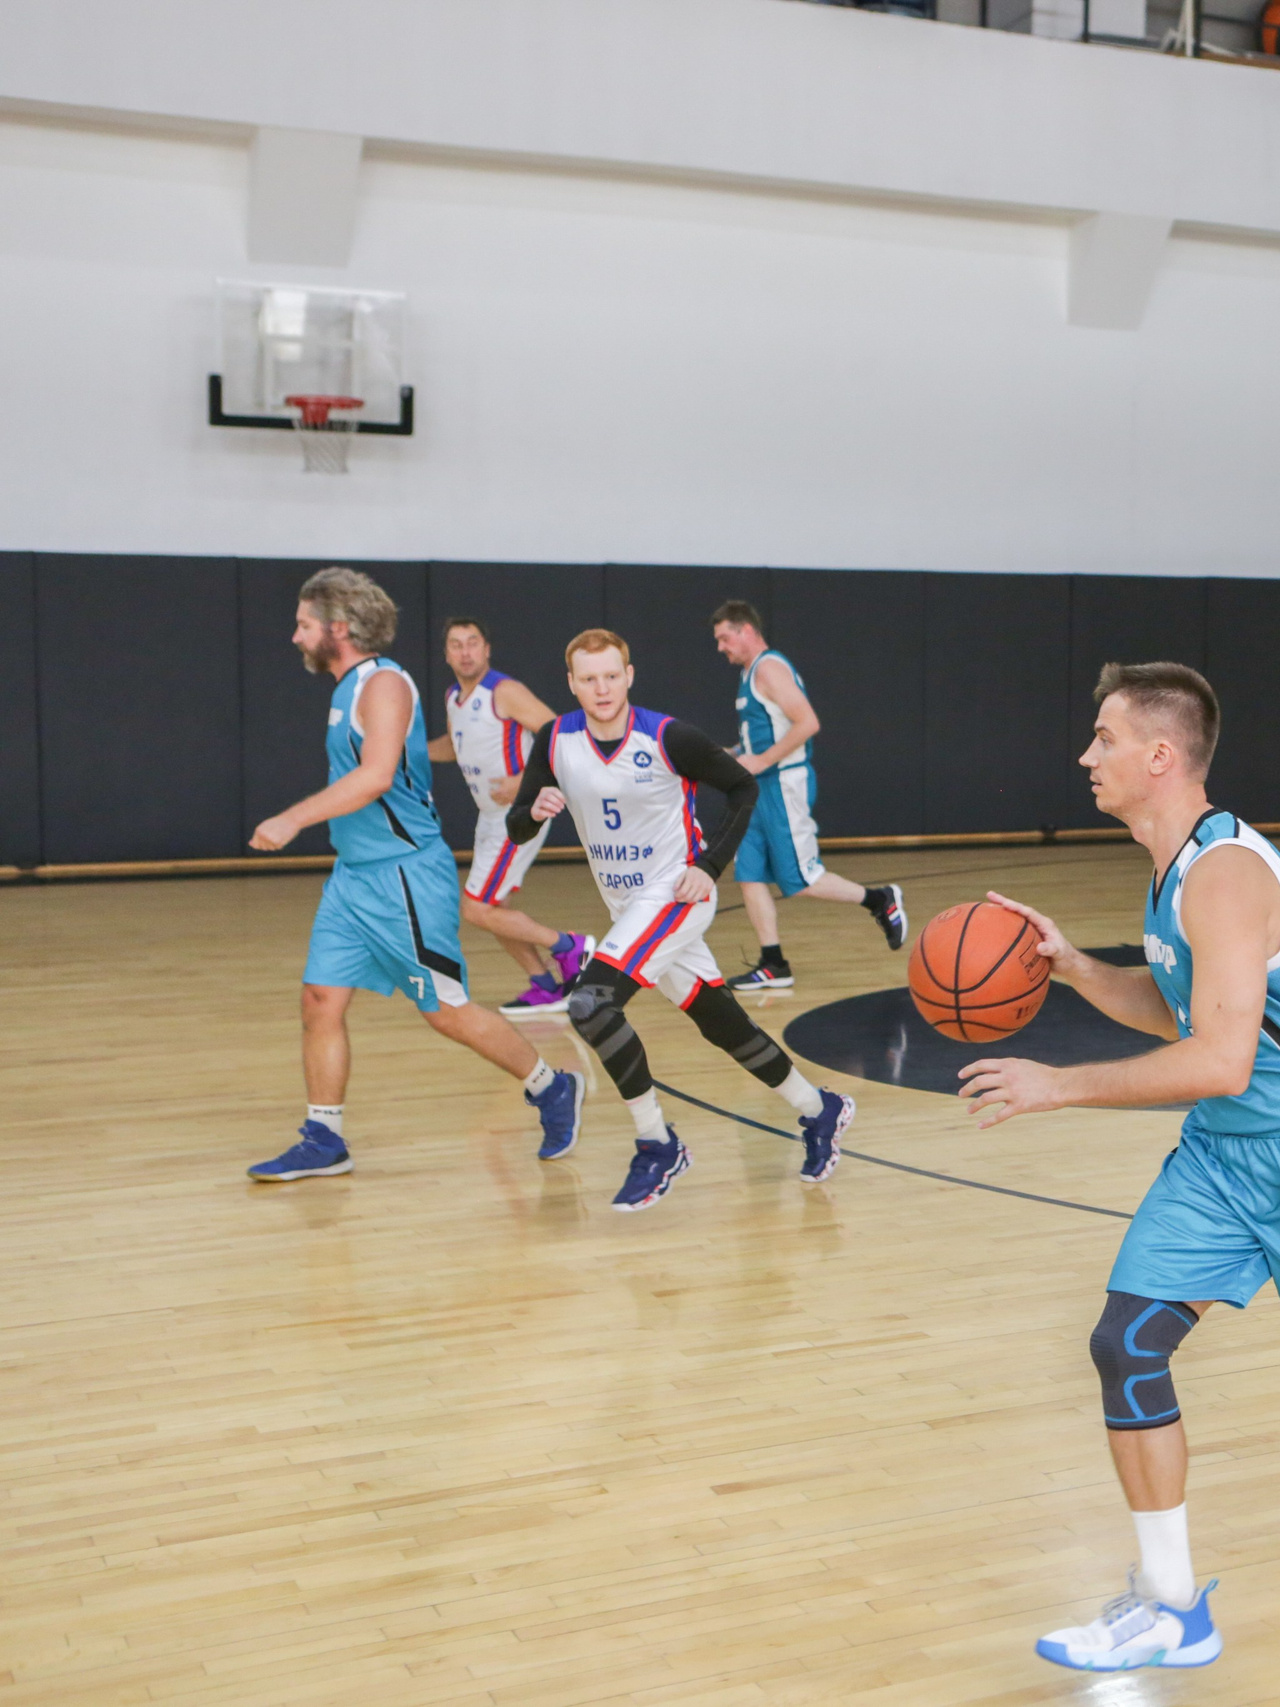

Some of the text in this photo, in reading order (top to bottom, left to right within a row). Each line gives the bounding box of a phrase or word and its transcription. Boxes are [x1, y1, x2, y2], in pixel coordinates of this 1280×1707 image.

[601, 798, 621, 831] 5
[598, 872, 644, 889] САРОВ
[408, 975, 425, 1000] 7
